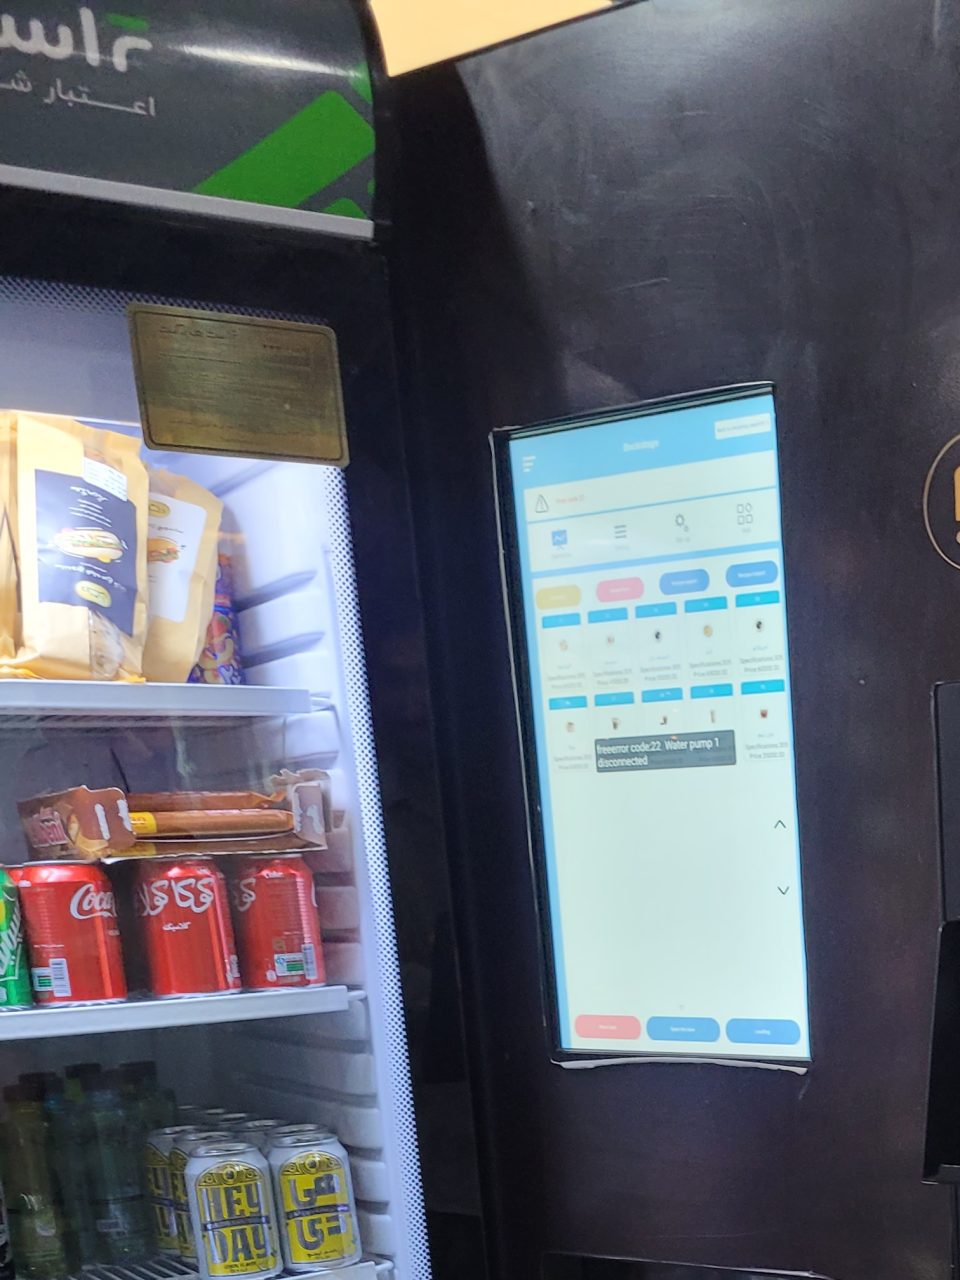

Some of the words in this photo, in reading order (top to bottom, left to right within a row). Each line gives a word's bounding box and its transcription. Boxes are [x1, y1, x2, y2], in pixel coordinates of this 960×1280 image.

[0, 6, 153, 73] تراس
[42, 78, 156, 117] اعتبار
[597, 756, 649, 769] disconnected
[663, 739, 688, 751] Water
[689, 738, 713, 750] pump
[202, 1179, 263, 1223] HEY
[209, 1226, 269, 1264] DAY
